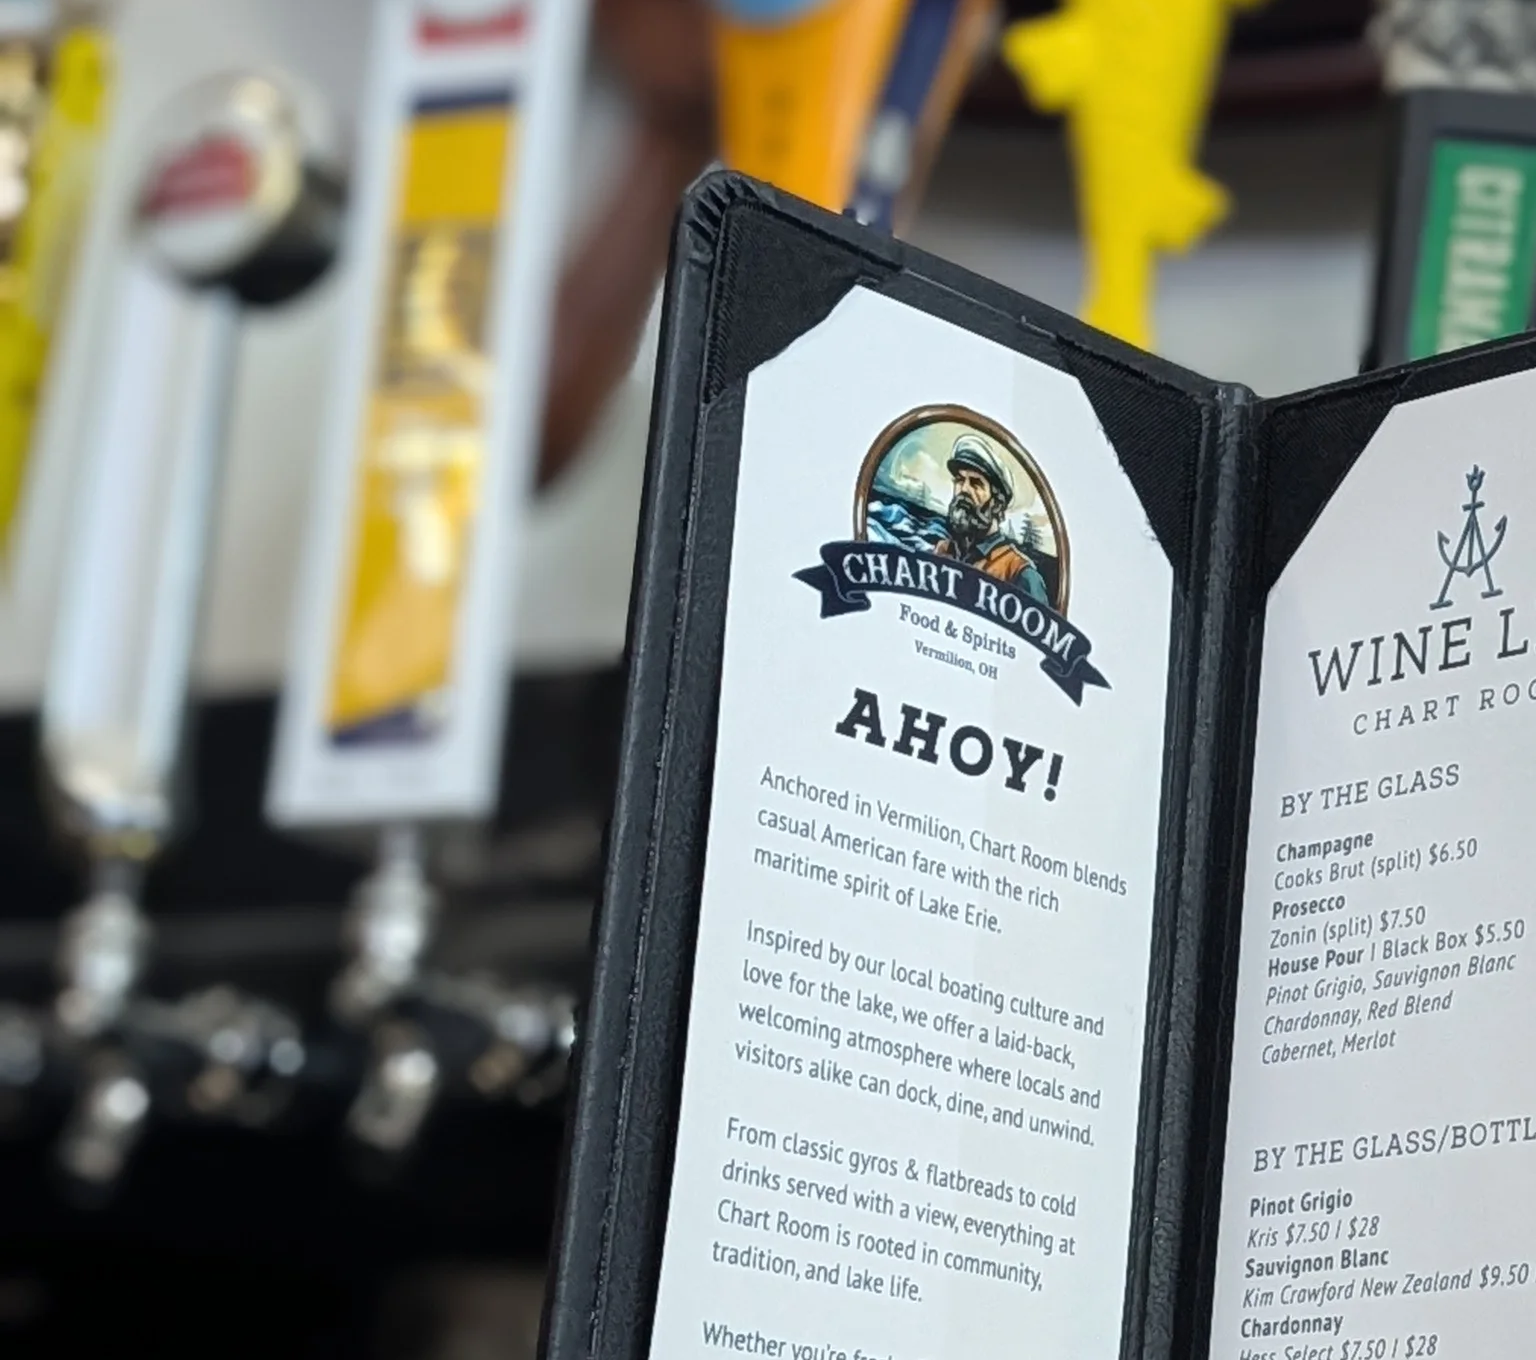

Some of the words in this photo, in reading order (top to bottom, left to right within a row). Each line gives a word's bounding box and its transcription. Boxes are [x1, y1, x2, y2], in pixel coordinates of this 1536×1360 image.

[842, 552, 964, 600] CHART
[974, 578, 1077, 662] ROOM
[899, 603, 941, 634] Food
[944, 619, 959, 640] &
[962, 626, 1017, 660] Spirits
[914, 640, 976, 675] Vermilion,
[978, 661, 999, 681] OH
[1307, 616, 1473, 697] WINE
[1353, 694, 1460, 736] CHART
[835, 687, 1064, 802] AHOY!
[1280, 790, 1314, 819] BY
[1320, 780, 1369, 810] THE
[1377, 763, 1460, 799] GLASS
[760, 765, 849, 811] Anchored
[855, 793, 872, 818] in
[876, 799, 965, 851] Vermilion,
[969, 829, 1016, 863] Chart
[1021, 844, 1068, 878] Room
[1073, 861, 1127, 896] blends
[1276, 832, 1374, 863] Champagne
[757, 809, 817, 842] casual
[820, 823, 907, 867] American
[912, 849, 947, 880] fare
[951, 865, 990, 892] with
[995, 875, 1023, 902] the
[1028, 886, 1059, 913] rich
[1274, 867, 1323, 891] Cooks
[1329, 860, 1365, 883] Brut
[1370, 847, 1422, 879] (split)
[1428, 837, 1478, 867] $6.50
[754, 847, 838, 886] maritime
[843, 873, 890, 902] spirit
[895, 887, 915, 907] of
[919, 889, 959, 921] Lake
[964, 902, 1002, 934] Erie.
[1271, 895, 1346, 921] Prosecco
[1268, 956, 1320, 978] House
[1324, 948, 1365, 969] Pour
[1382, 934, 1429, 960] Black
[1435, 931, 1468, 952] Box
[1474, 918, 1525, 947] $5.50
[1269, 924, 1317, 950] Zonin
[1322, 914, 1373, 946] (split)
[1379, 905, 1426, 933] $7.50
[1265, 983, 1309, 1007] Pinot
[1313, 974, 1367, 1001] Grigio,
[1372, 962, 1461, 991] Sauvignon
[1467, 954, 1517, 977] Blanc
[1263, 1008, 1362, 1036] Chardonnay,
[1366, 997, 1400, 1021] Red
[1403, 989, 1454, 1016] Blend
[1262, 1038, 1336, 1065] Cabernet,
[1341, 1029, 1397, 1054] Merlot
[726, 1116, 777, 1150] From
[782, 1132, 844, 1165] classic
[848, 1151, 898, 1177] gyros
[904, 1158, 919, 1182] &
[926, 1163, 1013, 1203] flatbreads
[1018, 1186, 1036, 1208] to
[1040, 1194, 1077, 1217] cold
[1253, 1146, 1287, 1173] BY
[1294, 1139, 1344, 1168] THE
[722, 1158, 781, 1192] drinks
[785, 1177, 848, 1206] served
[853, 1189, 894, 1216] with
[899, 1202, 910, 1219] a
[915, 1202, 959, 1234] view,
[963, 1216, 1054, 1256] everything
[1058, 1237, 1076, 1256] at
[1249, 1196, 1295, 1218] Pinot
[1300, 1187, 1353, 1215] Grigio
[717, 1198, 771, 1231] Chart
[776, 1210, 830, 1243] Room
[835, 1223, 851, 1248] is
[856, 1233, 917, 1261] rooted
[921, 1241, 939, 1266] in
[943, 1251, 1043, 1292] community,
[1247, 1226, 1279, 1249] Kris
[1284, 1220, 1330, 1247] $7.50
[1347, 1215, 1380, 1241] $28
[1242, 1287, 1274, 1309] Kim
[1280, 1278, 1356, 1308] Crawford
[1359, 1277, 1398, 1298] New
[1401, 1268, 1473, 1295] Zealand
[1479, 1262, 1530, 1290] $9.50
[1244, 1254, 1334, 1280] Sauvignon
[1340, 1248, 1390, 1270] Blanc
[1240, 1314, 1344, 1339] Chardonnay
[1404, 1334, 1438, 1360] $28
